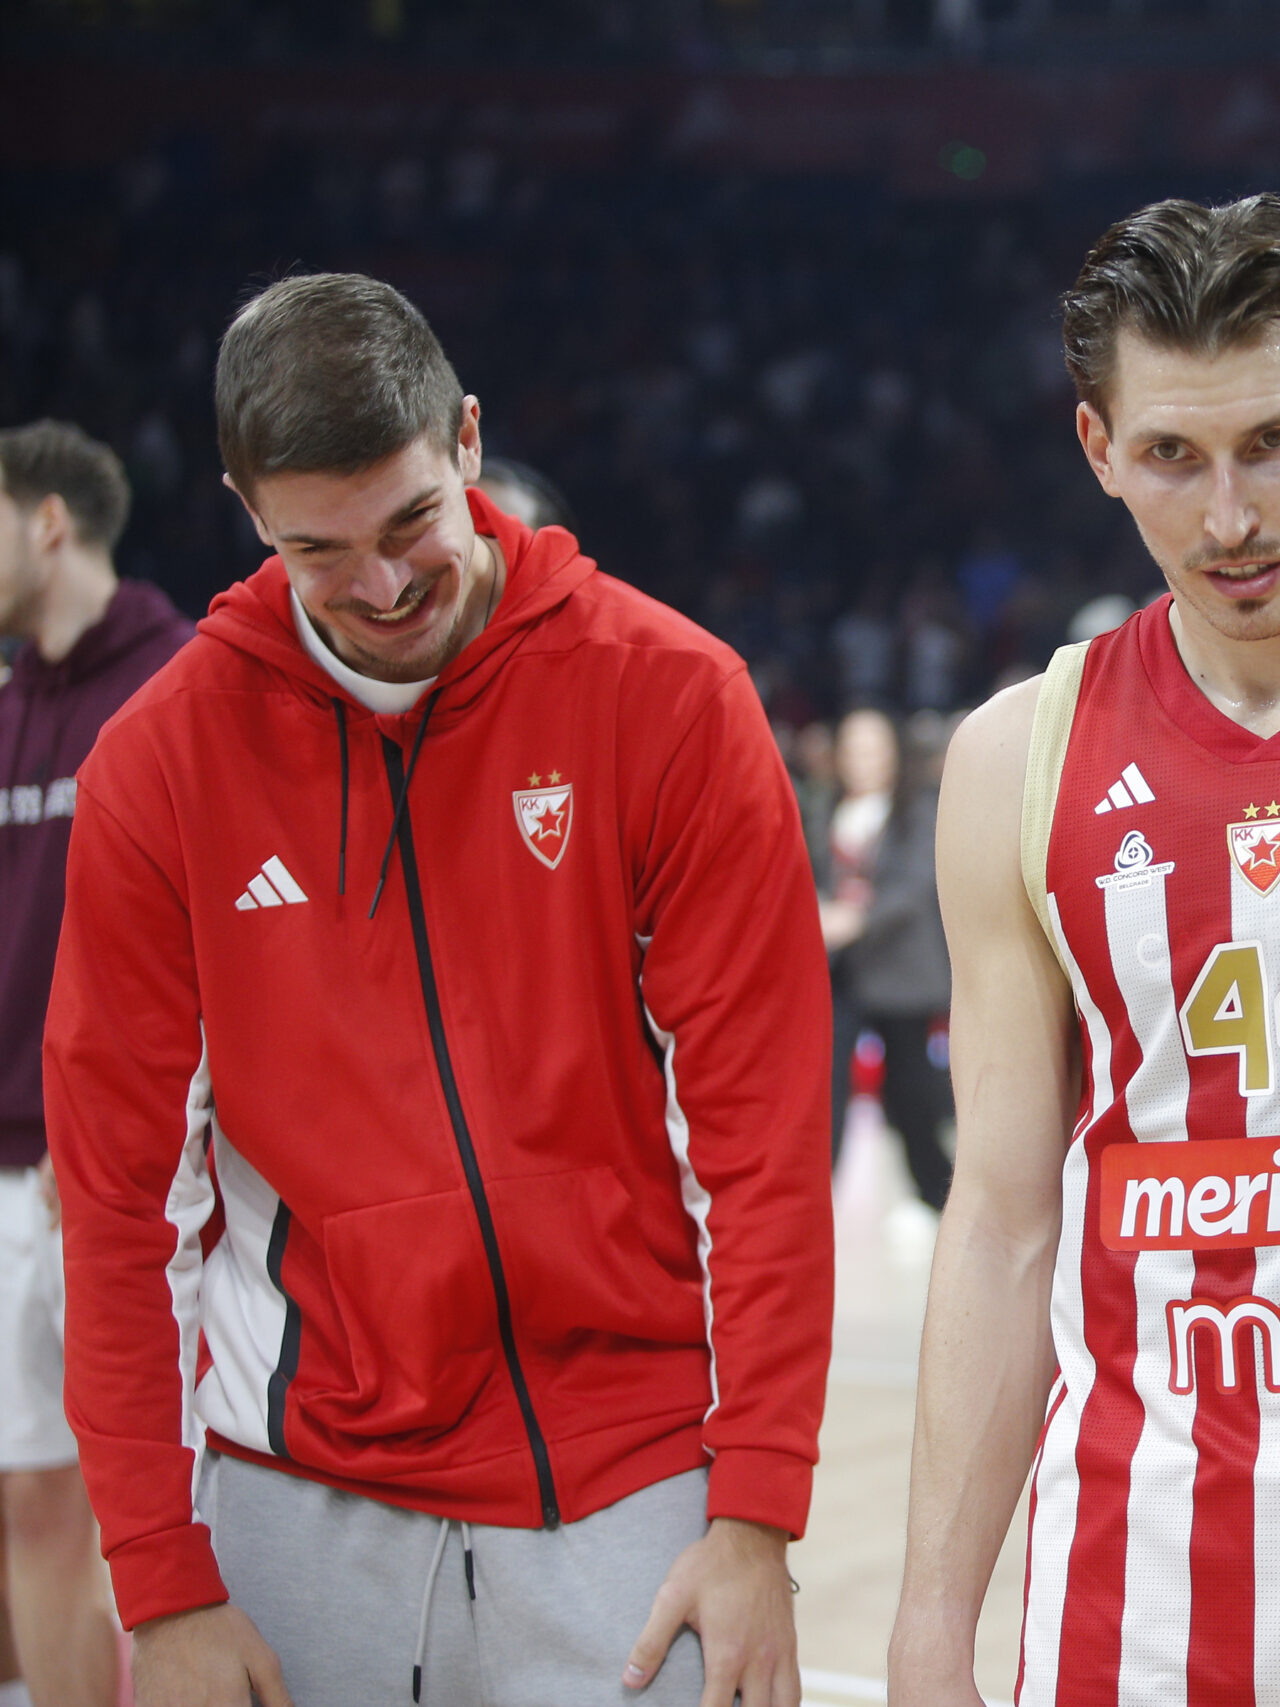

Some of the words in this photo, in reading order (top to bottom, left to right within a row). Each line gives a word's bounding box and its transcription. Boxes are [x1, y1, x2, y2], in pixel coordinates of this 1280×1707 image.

[521, 797, 540, 811] KK
[1234, 827, 1254, 842] KK
[1113, 869, 1149, 882] CONCORD
[1150, 865, 1171, 874] WEST
[1119, 880, 1149, 889] BELGRADE
